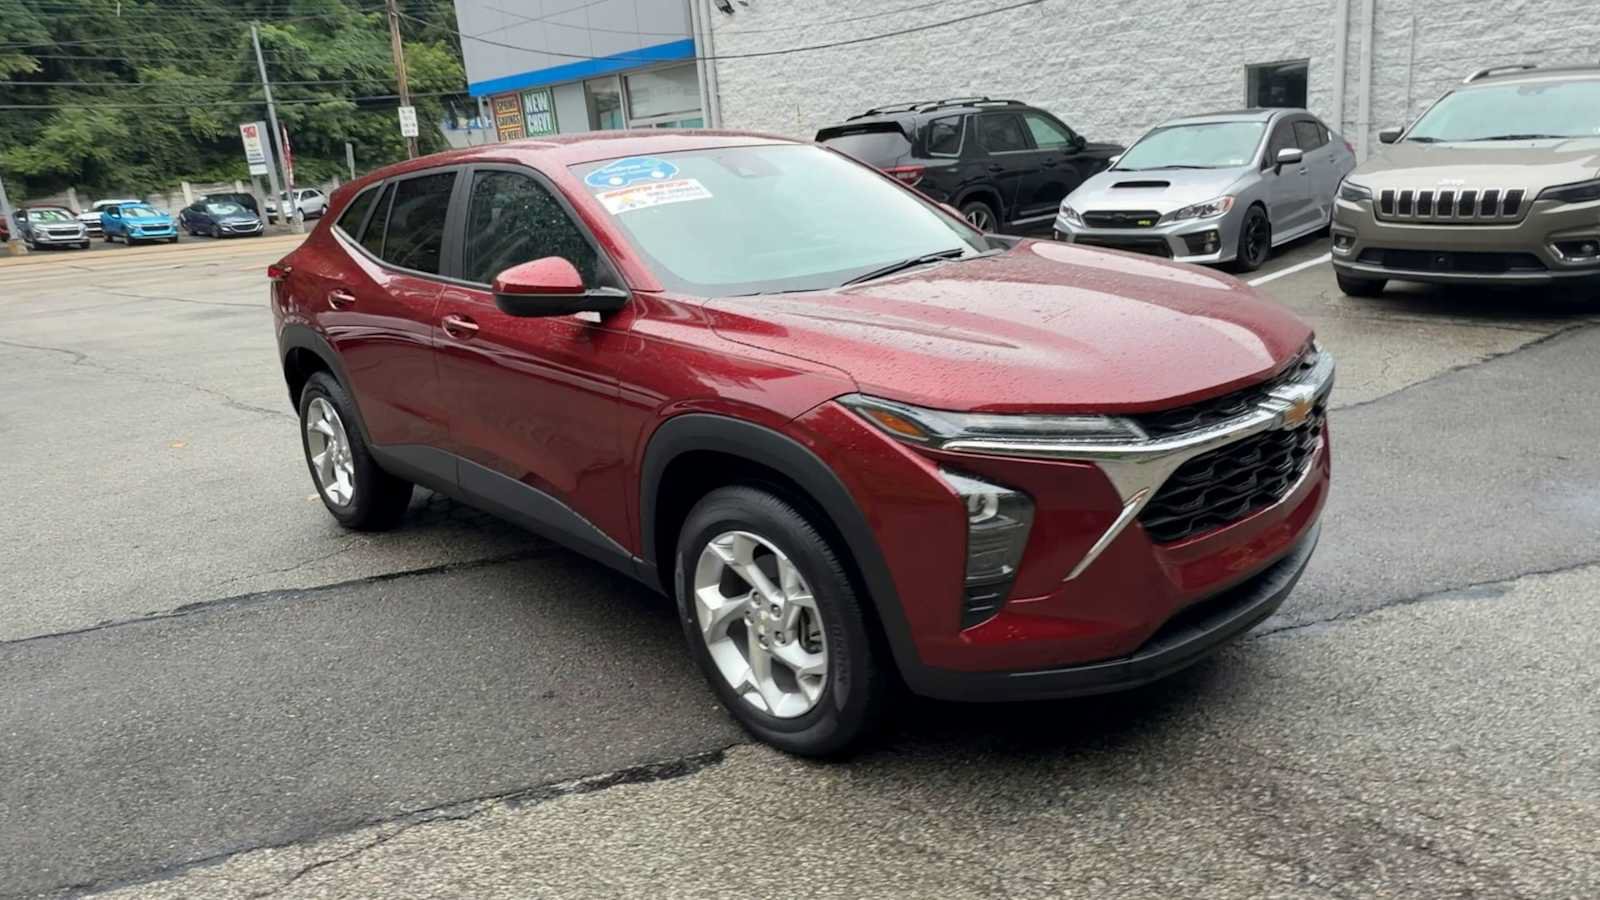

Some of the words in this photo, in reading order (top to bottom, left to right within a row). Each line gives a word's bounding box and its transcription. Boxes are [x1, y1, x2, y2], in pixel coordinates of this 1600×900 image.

[525, 91, 549, 112] NEW
[497, 112, 521, 128] SAVINGS
[527, 112, 551, 133] CHEVY
